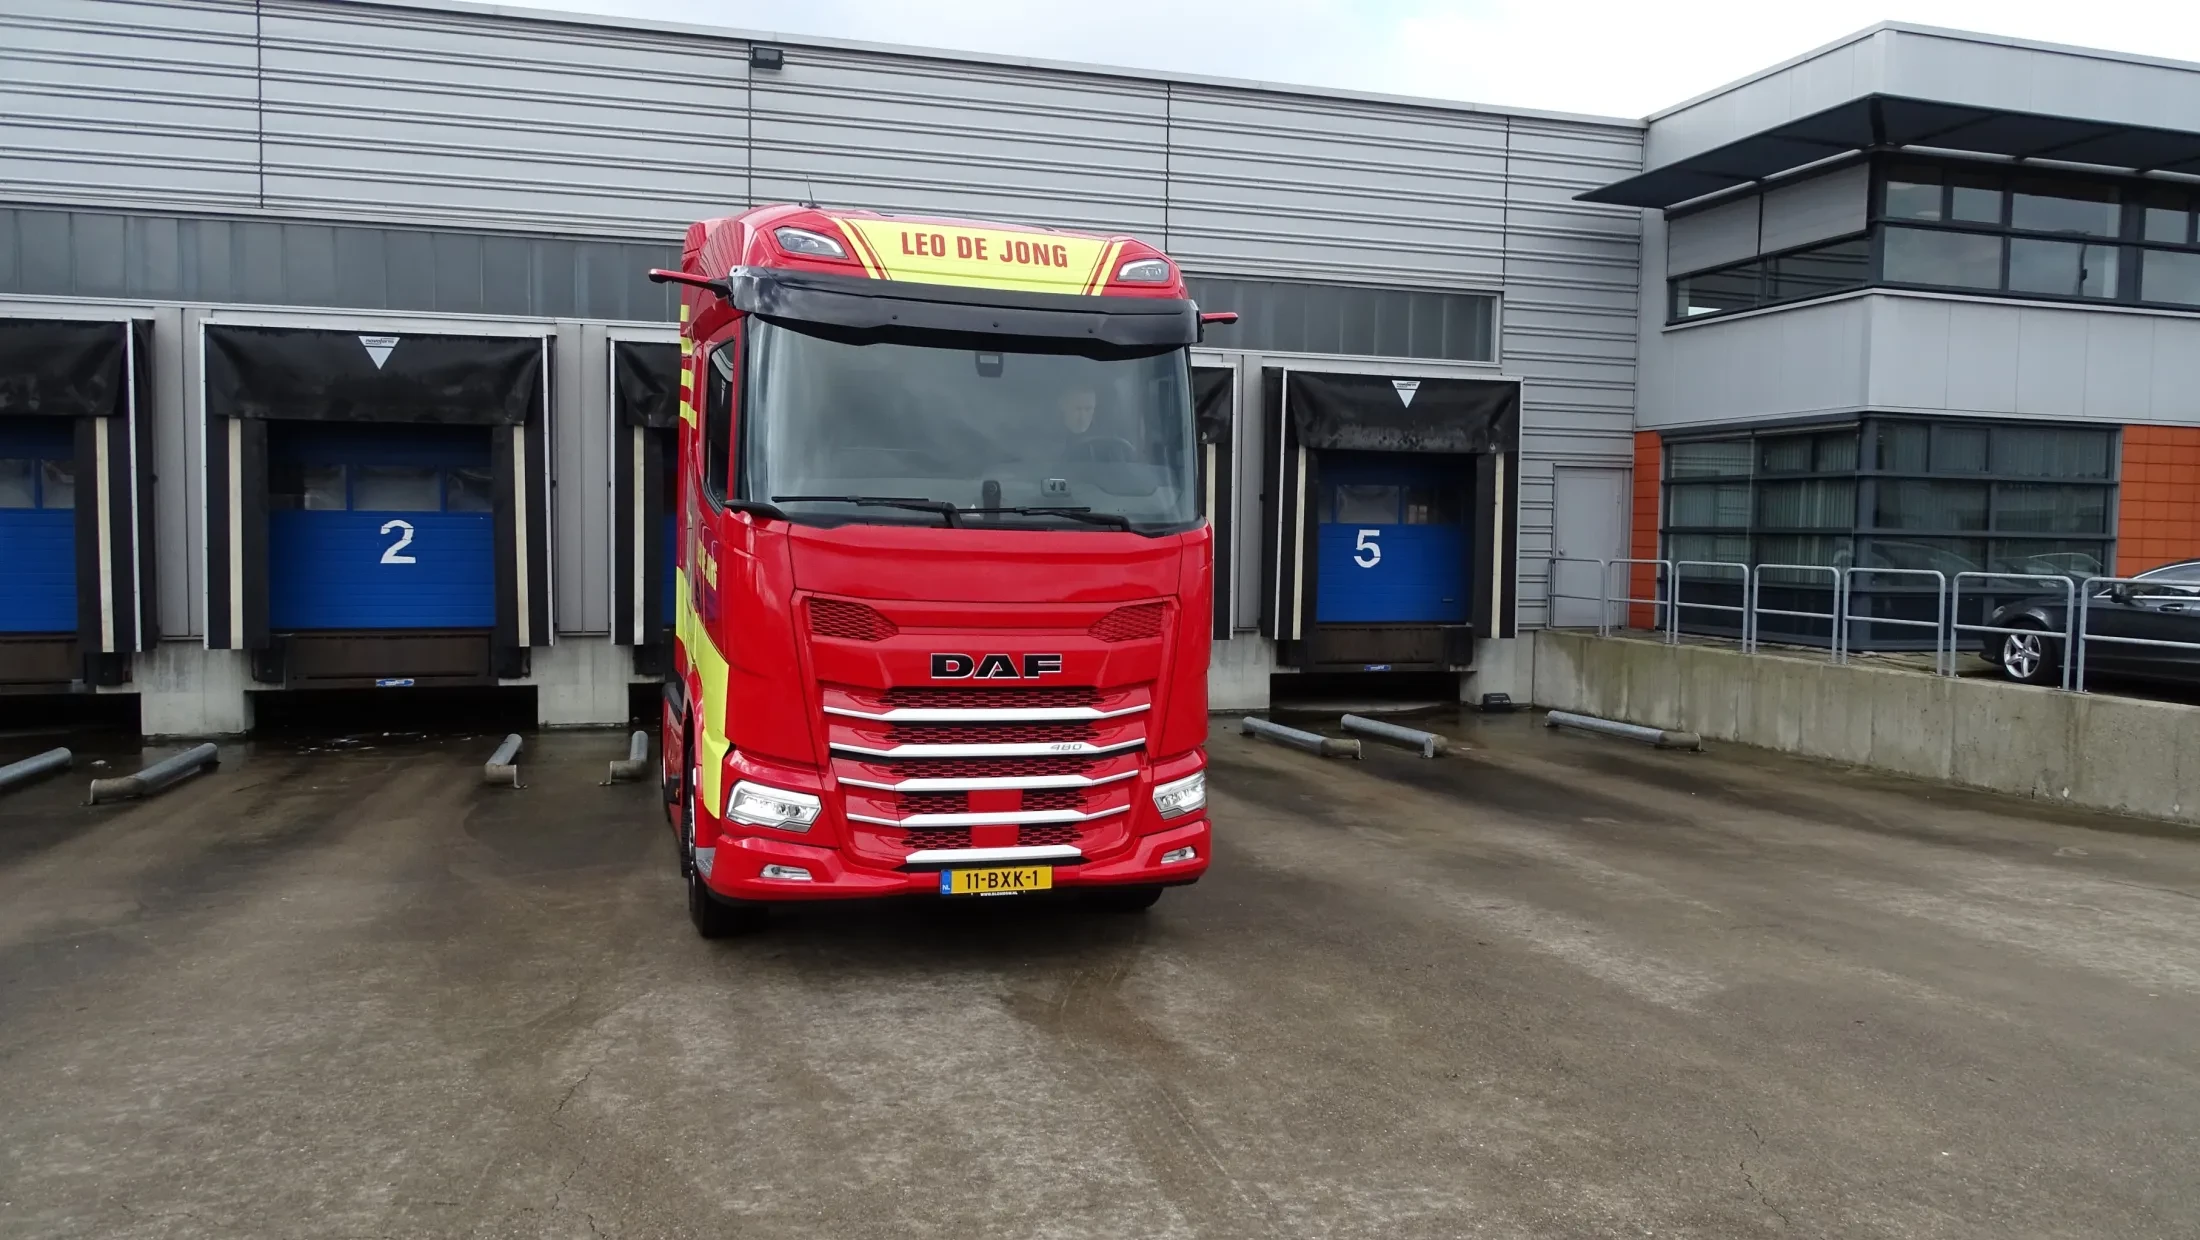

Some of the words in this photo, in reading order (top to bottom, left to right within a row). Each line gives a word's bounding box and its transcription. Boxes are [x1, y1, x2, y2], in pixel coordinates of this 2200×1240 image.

[901, 232, 946, 257] LEO
[957, 236, 988, 260] DE
[1000, 240, 1068, 268] JONG
[380, 519, 416, 564] 2
[1353, 529, 1381, 568] 5
[930, 652, 1063, 679] DAF
[1050, 743, 1083, 751] 480
[965, 870, 1038, 889] 11-BXK-1
